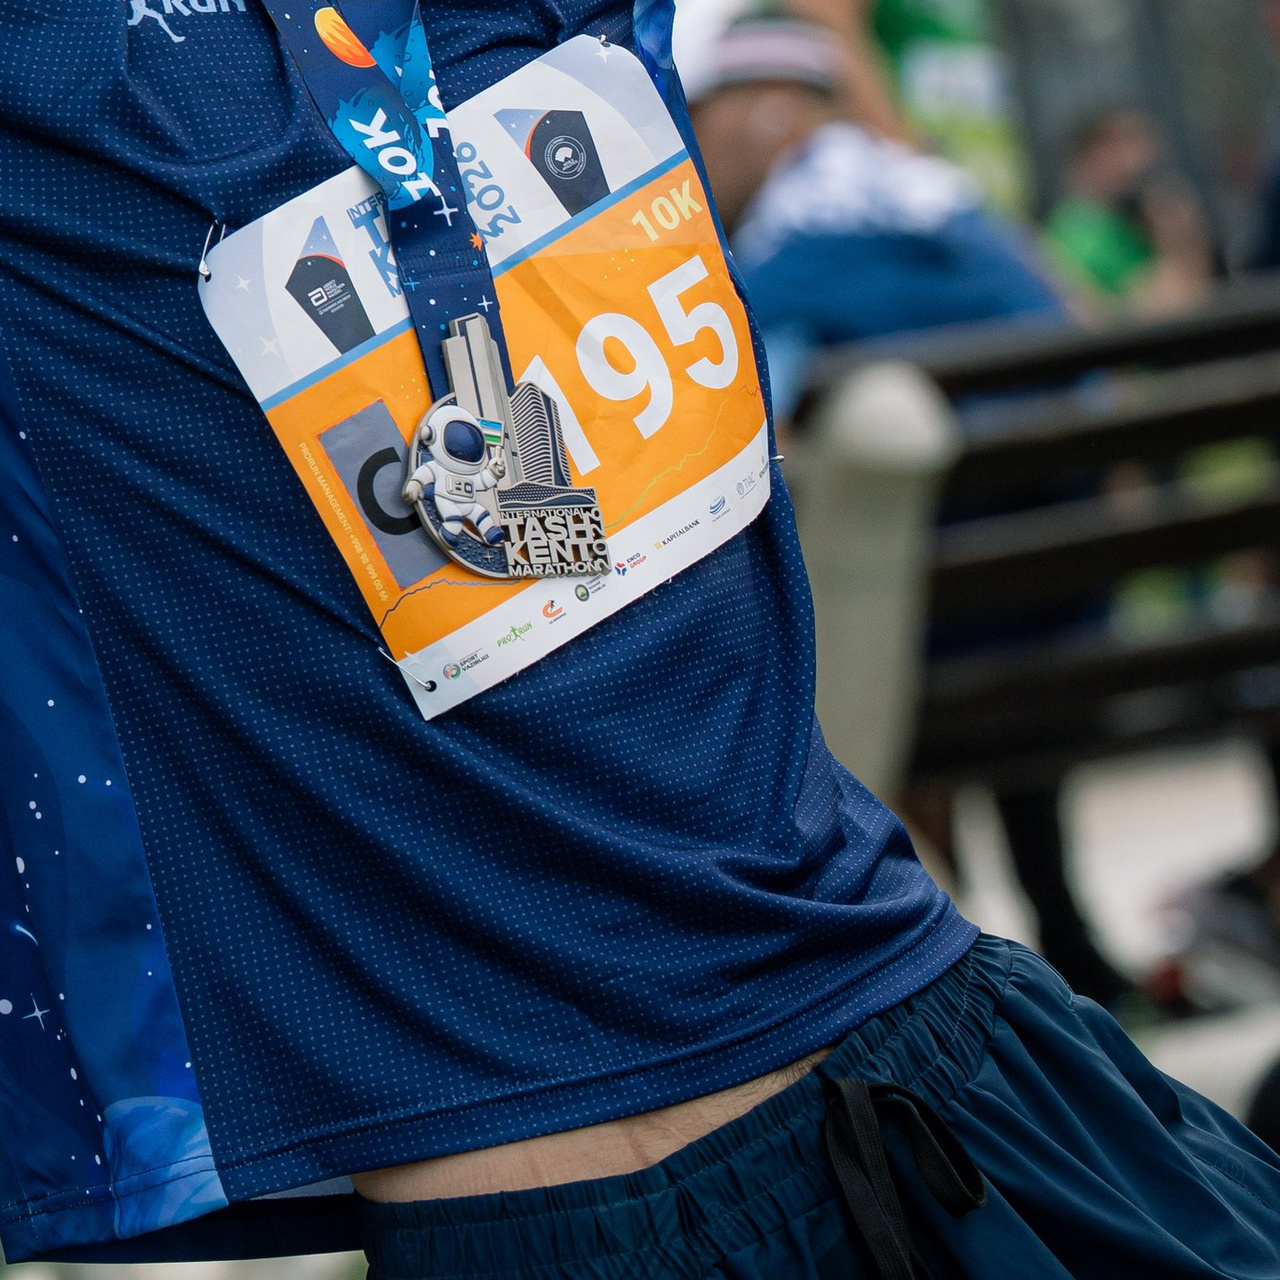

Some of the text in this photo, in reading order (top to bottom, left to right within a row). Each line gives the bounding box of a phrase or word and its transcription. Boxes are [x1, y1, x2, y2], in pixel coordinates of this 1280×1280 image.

[348, 107, 442, 201] 10K
[630, 178, 703, 242] 10K
[298, 441, 319, 477] PRORUN
[317, 472, 353, 534] MANAGEMENT:
[349, 534, 364, 554] +998
[360, 551, 369, 565] 98
[366, 562, 379, 581] 999
[500, 514, 594, 543] TASH
[661, 518, 701, 546] KAPITALBANK
[505, 538, 593, 566] KENT
[626, 552, 641, 563] ENCO
[629, 555, 647, 569] GROUP
[508, 560, 599, 577] MARATHON
[518, 621, 533, 635] RUN
[459, 653, 479, 667] SPORT
[461, 653, 490, 672] VAZIRLIGI
